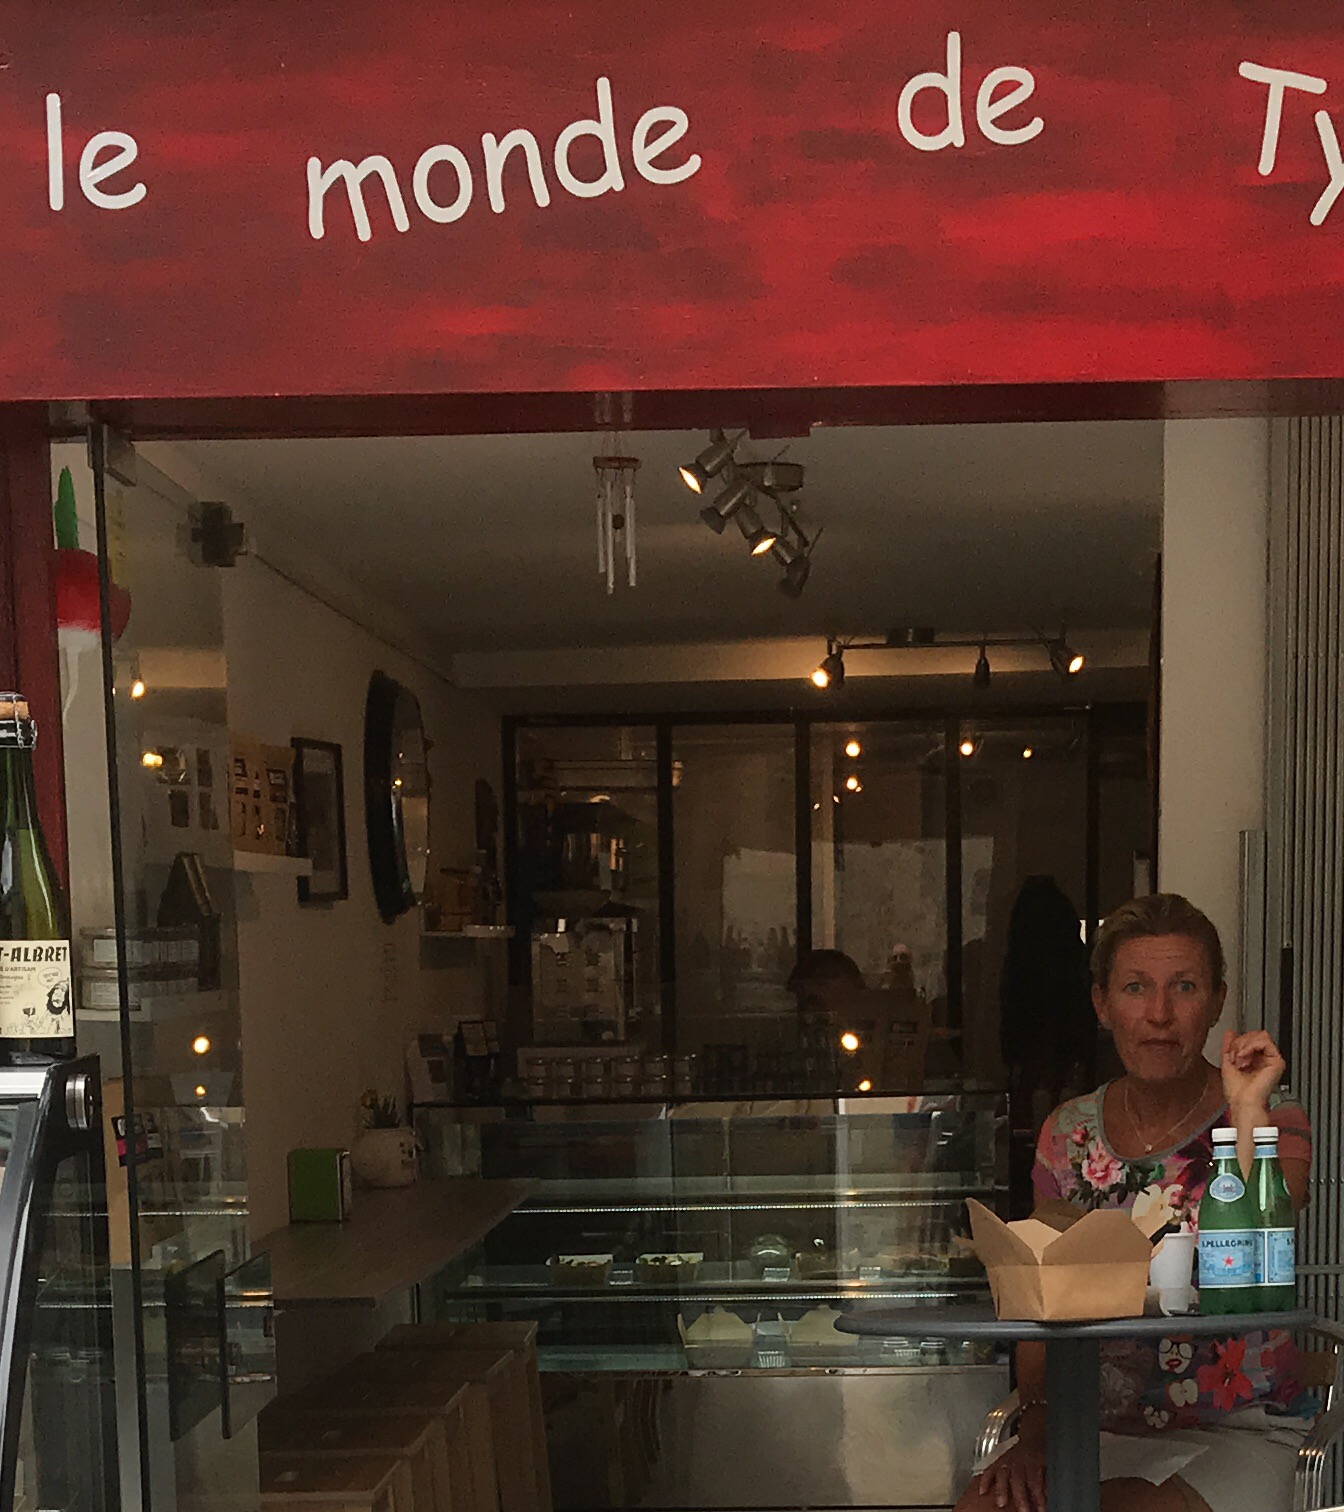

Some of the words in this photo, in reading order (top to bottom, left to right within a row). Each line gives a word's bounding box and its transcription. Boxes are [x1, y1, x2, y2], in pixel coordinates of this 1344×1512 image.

[46, 92, 147, 211] le
[307, 76, 702, 241] monde
[898, 30, 1044, 151] de
